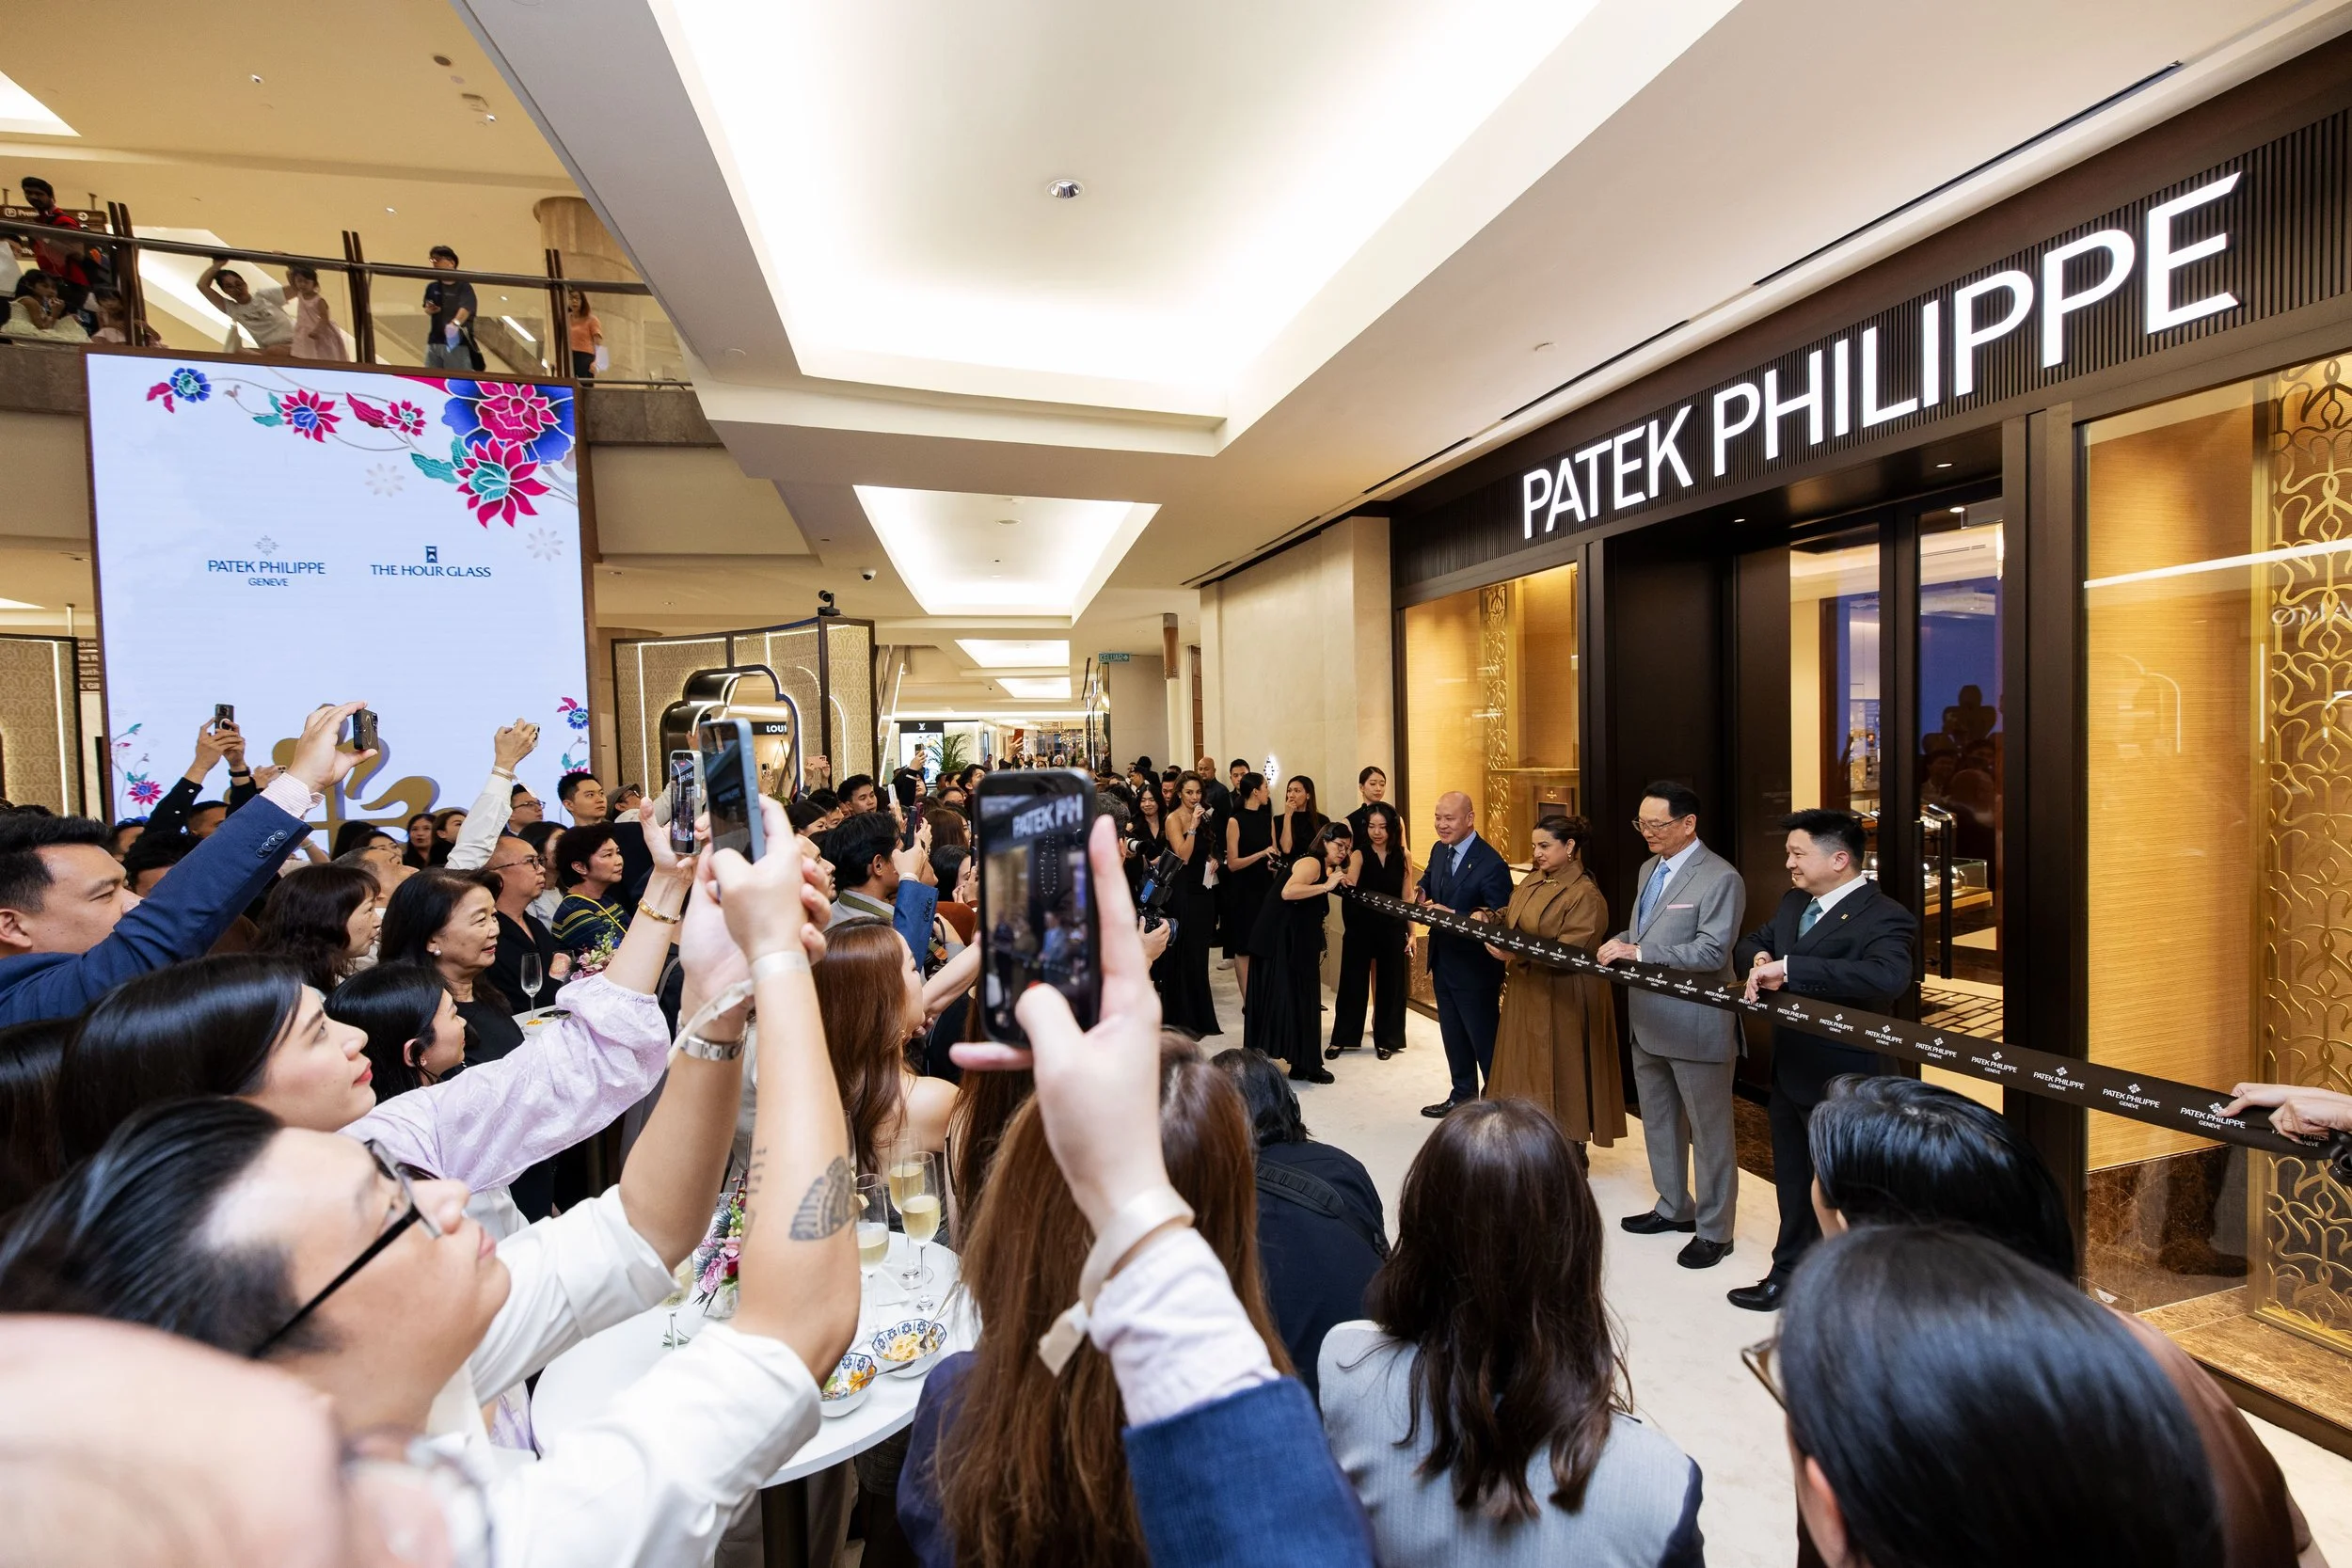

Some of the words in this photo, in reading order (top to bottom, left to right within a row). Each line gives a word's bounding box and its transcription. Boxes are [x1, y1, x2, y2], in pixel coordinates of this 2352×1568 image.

[1524, 404, 1693, 540] PATEK
[1713, 171, 2242, 478] PHILIPPE
[208, 560, 256, 573] PATEK
[259, 561, 326, 574] PHILIPPE
[370, 564, 398, 576] THE
[401, 565, 445, 577] HOUR
[446, 566, 491, 578] GLASS
[248, 578, 289, 586] GENEVE
[1012, 801, 1055, 839] PATEK
[1865, 1029, 1881, 1038] PATEK
[1880, 1033, 1903, 1044] PHILIPPE
[1915, 1042, 1932, 1052] PATEK
[1931, 1046, 1958, 1058] PHILIPPE
[1927, 1052, 1943, 1060] GENEVE
[1971, 1055, 1990, 1067] PATEK
[1990, 1061, 2018, 1073] PHILIPPE
[1984, 1067, 2001, 1075] GENEVE
[2033, 1071, 2054, 1083] PATEK
[2054, 1076, 2086, 1090] PHILIPPE
[2047, 1083, 2067, 1091] GENEVE
[2102, 1088, 2126, 1100] PATEK
[2126, 1094, 2161, 1109] PHILIPPE
[2119, 1100, 2139, 1110] GENEVE
[2180, 1107, 2205, 1119] PATEK
[2206, 1113, 2247, 1129] PHILIPPE
[2198, 1119, 2221, 1131] GENEVE
